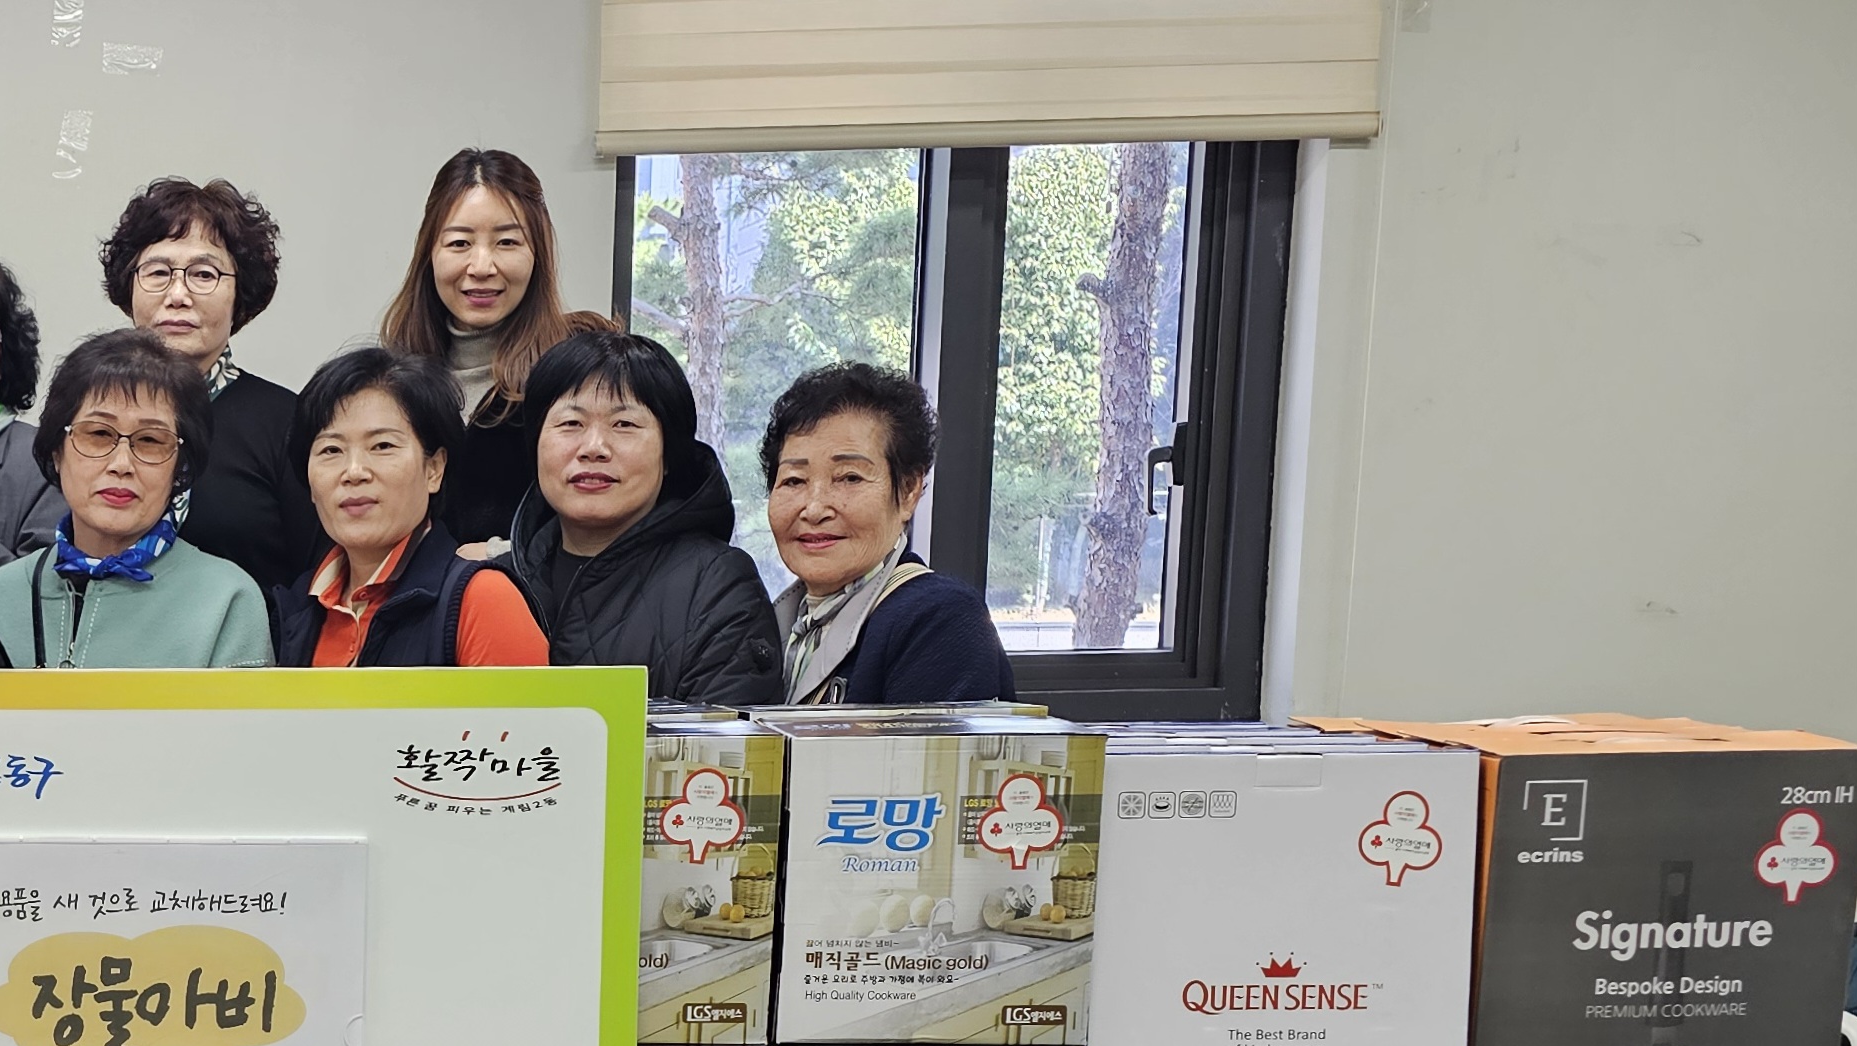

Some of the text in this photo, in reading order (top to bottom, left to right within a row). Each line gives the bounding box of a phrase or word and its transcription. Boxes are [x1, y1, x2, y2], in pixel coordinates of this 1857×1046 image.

[396, 744, 560, 782] 활짝마을
[394, 793, 421, 807] 푸른
[446, 805, 492, 815] 피우는
[501, 797, 558, 813] 계림2동
[1780, 785, 1855, 805] 28cm IH
[815, 792, 945, 853] 로망
[841, 854, 920, 874] Roman
[1517, 846, 1584, 864] ecrins
[52, 892, 79, 913] 새
[89, 888, 140, 918] 것으로
[149, 888, 287, 915] 교체해드려요!
[1572, 909, 1773, 962] Signature
[806, 952, 989, 970] 매직골드 (Magic gold)
[1182, 979, 1368, 1015] QUEEN SENSE
[1594, 975, 1743, 998] Bespoke Design
[1228, 1029, 1326, 1040] The Best Brand
